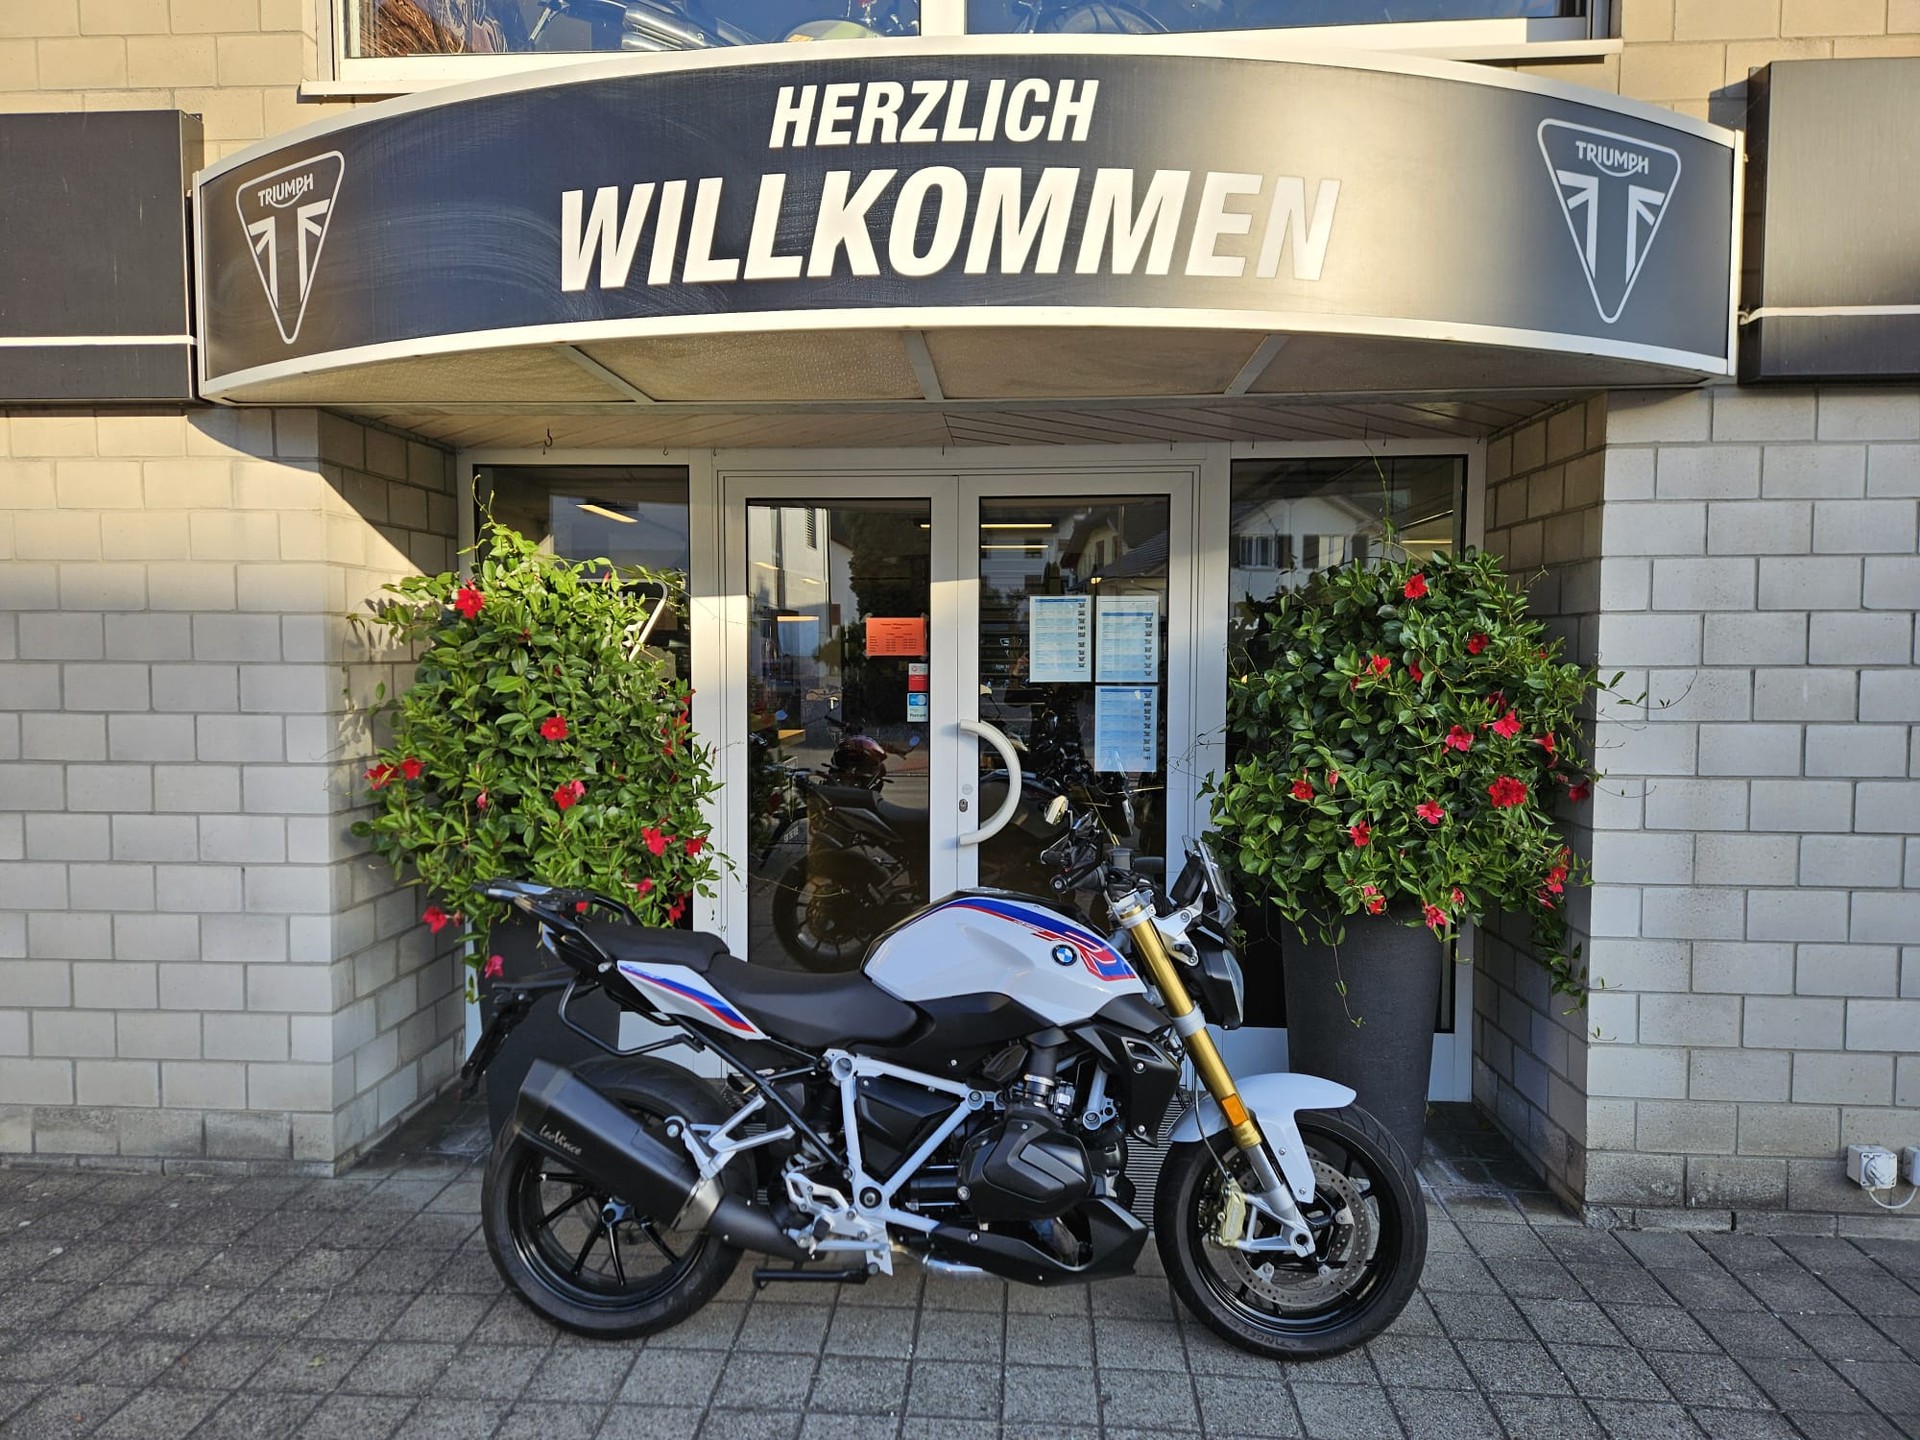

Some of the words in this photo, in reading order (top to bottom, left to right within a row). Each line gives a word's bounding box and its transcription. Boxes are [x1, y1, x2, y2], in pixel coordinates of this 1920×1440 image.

[768, 78, 1099, 148] HERZLICH
[1575, 140, 1649, 177] TRIUMPH
[257, 172, 314, 208] TRIUMPH
[561, 165, 1341, 292] WILLKOMMEN
